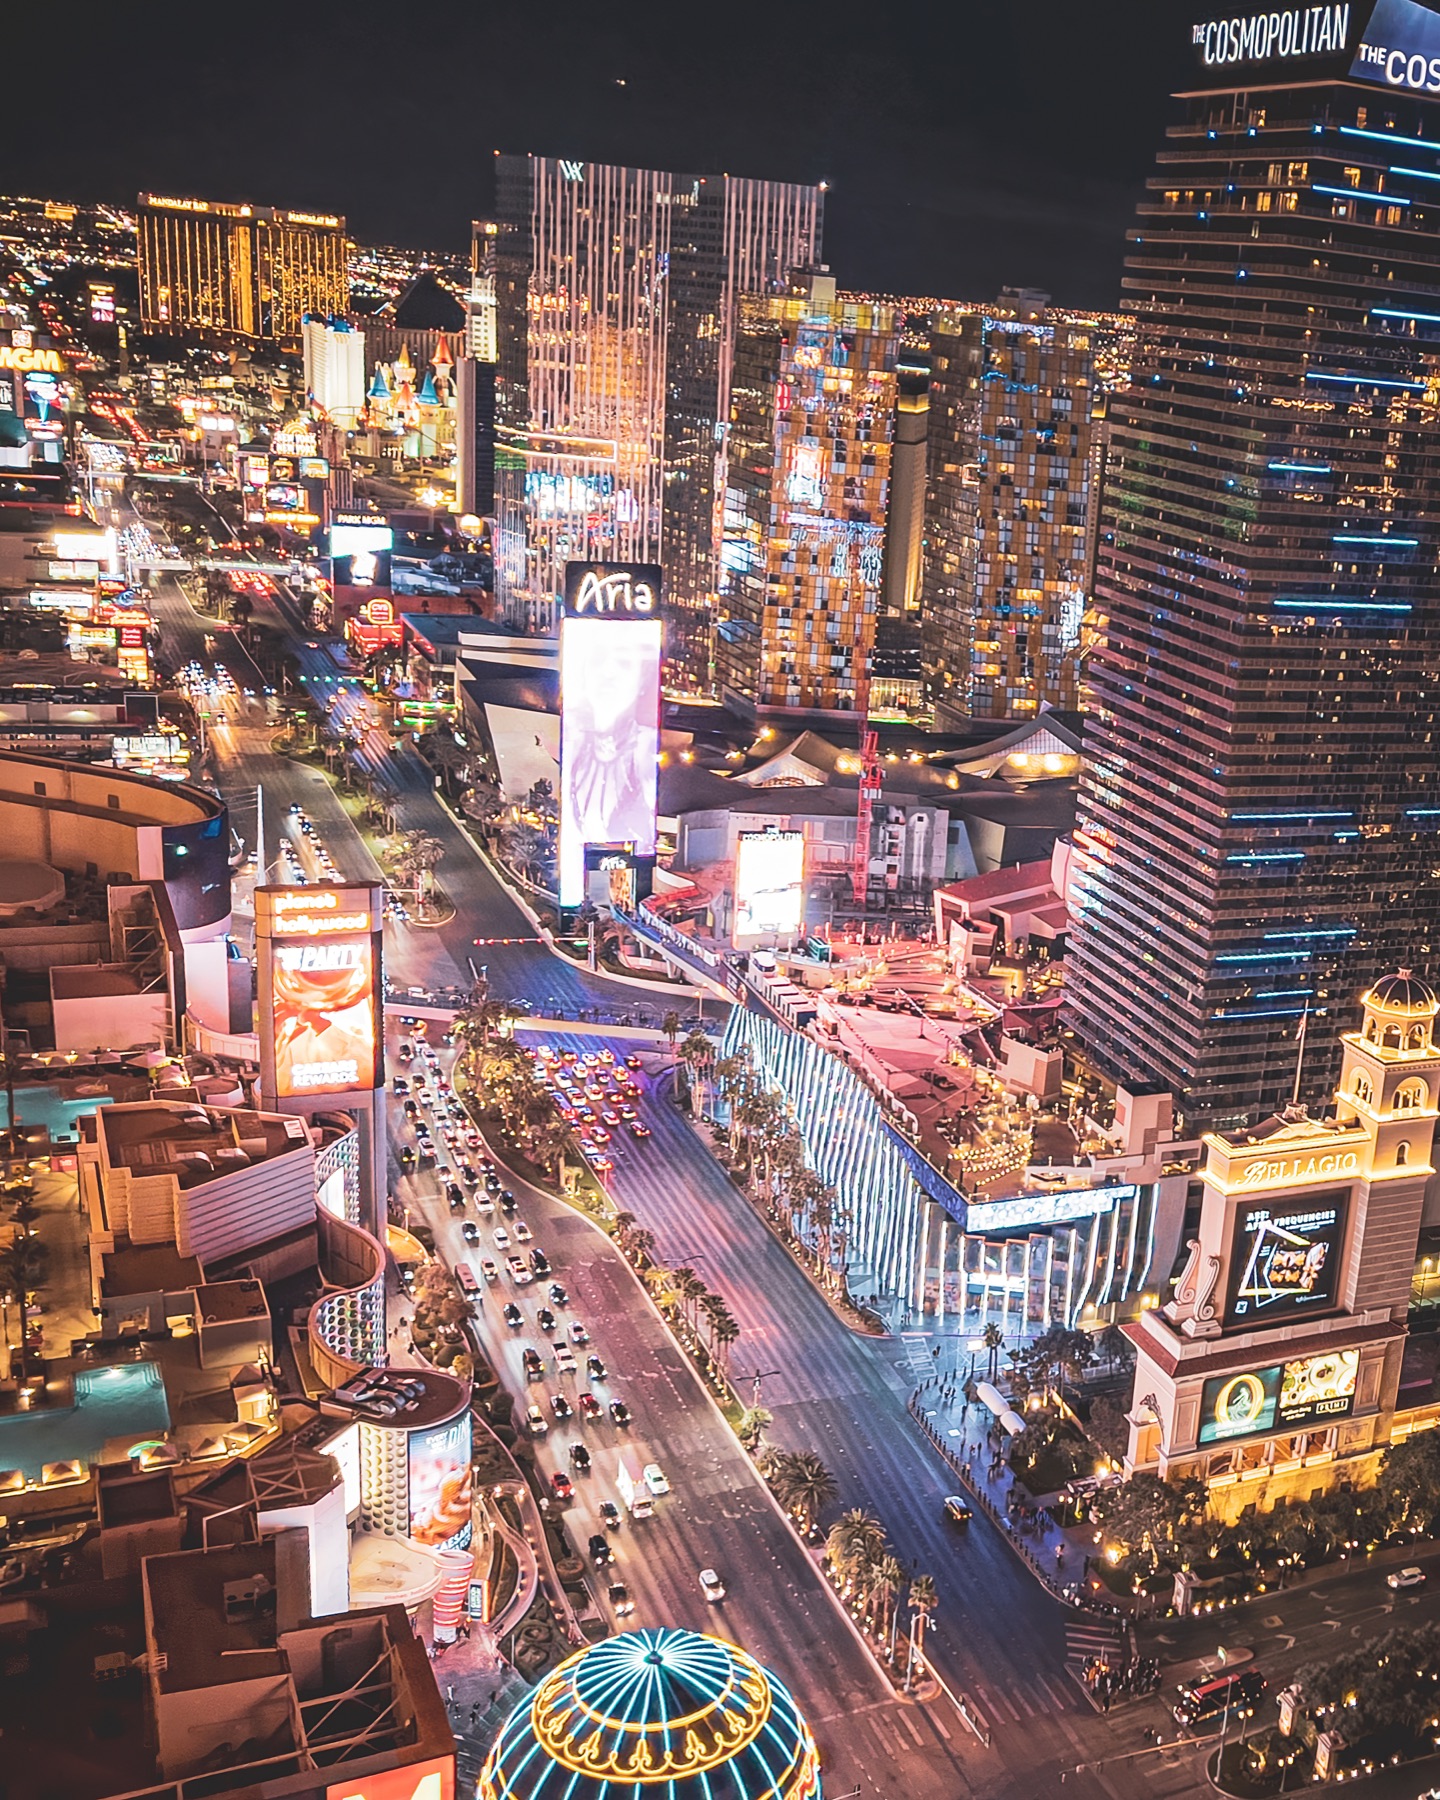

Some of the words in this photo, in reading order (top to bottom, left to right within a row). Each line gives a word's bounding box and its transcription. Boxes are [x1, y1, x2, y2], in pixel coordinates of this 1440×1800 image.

[1193, 24, 1205, 43] THE
[1204, 3, 1349, 65] COSMOPOLITAN
[1359, 43, 1387, 65] THE
[1386, 50, 1440, 92] COS
[149, 197, 191, 210] MANDALAY
[193, 201, 208, 211] BAY
[338, 514, 361, 524] PARK
[362, 516, 386, 525] MGM
[576, 571, 653, 613] Aria
[743, 833, 803, 841] COSMOPOLITAN
[600, 856, 627, 871] Aria
[275, 893, 337, 915] planet
[275, 913, 368, 935] hollywood
[301, 945, 364, 972] PARTY
[1236, 1153, 1357, 1184] BELLAGIO
[1274, 1210, 1336, 1227] FREQUENCIES
